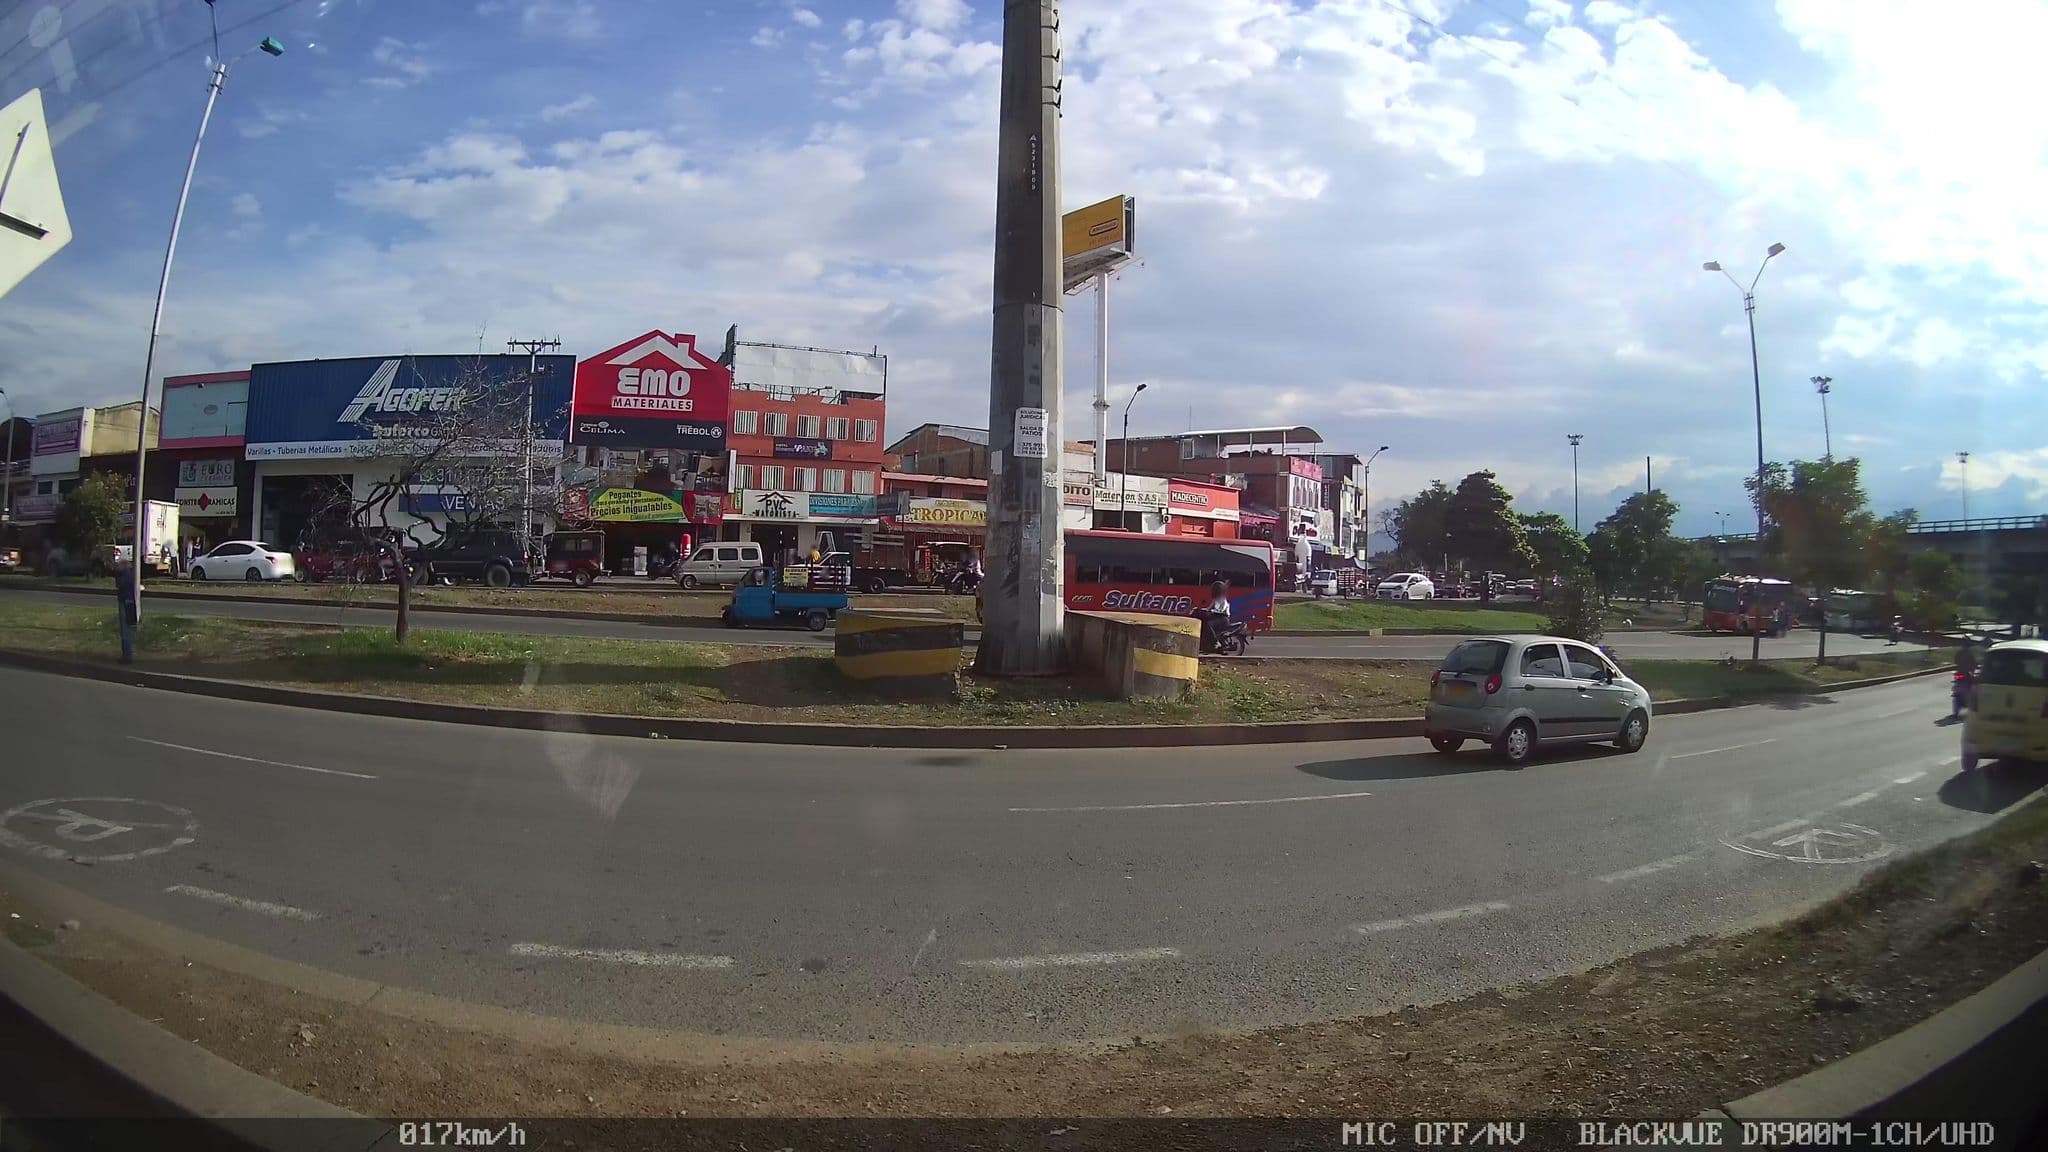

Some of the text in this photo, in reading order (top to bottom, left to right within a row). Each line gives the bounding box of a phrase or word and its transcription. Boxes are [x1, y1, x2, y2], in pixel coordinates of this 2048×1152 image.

[617, 367, 691, 397] EMO
[613, 397, 691, 410] MATERIALES
[580, 426, 626, 435] CELIMA
[609, 491, 642, 500] Pegantes
[765, 499, 787, 511] PVC
[591, 506, 621, 517] Precios
[1102, 589, 1192, 614] Sultana
